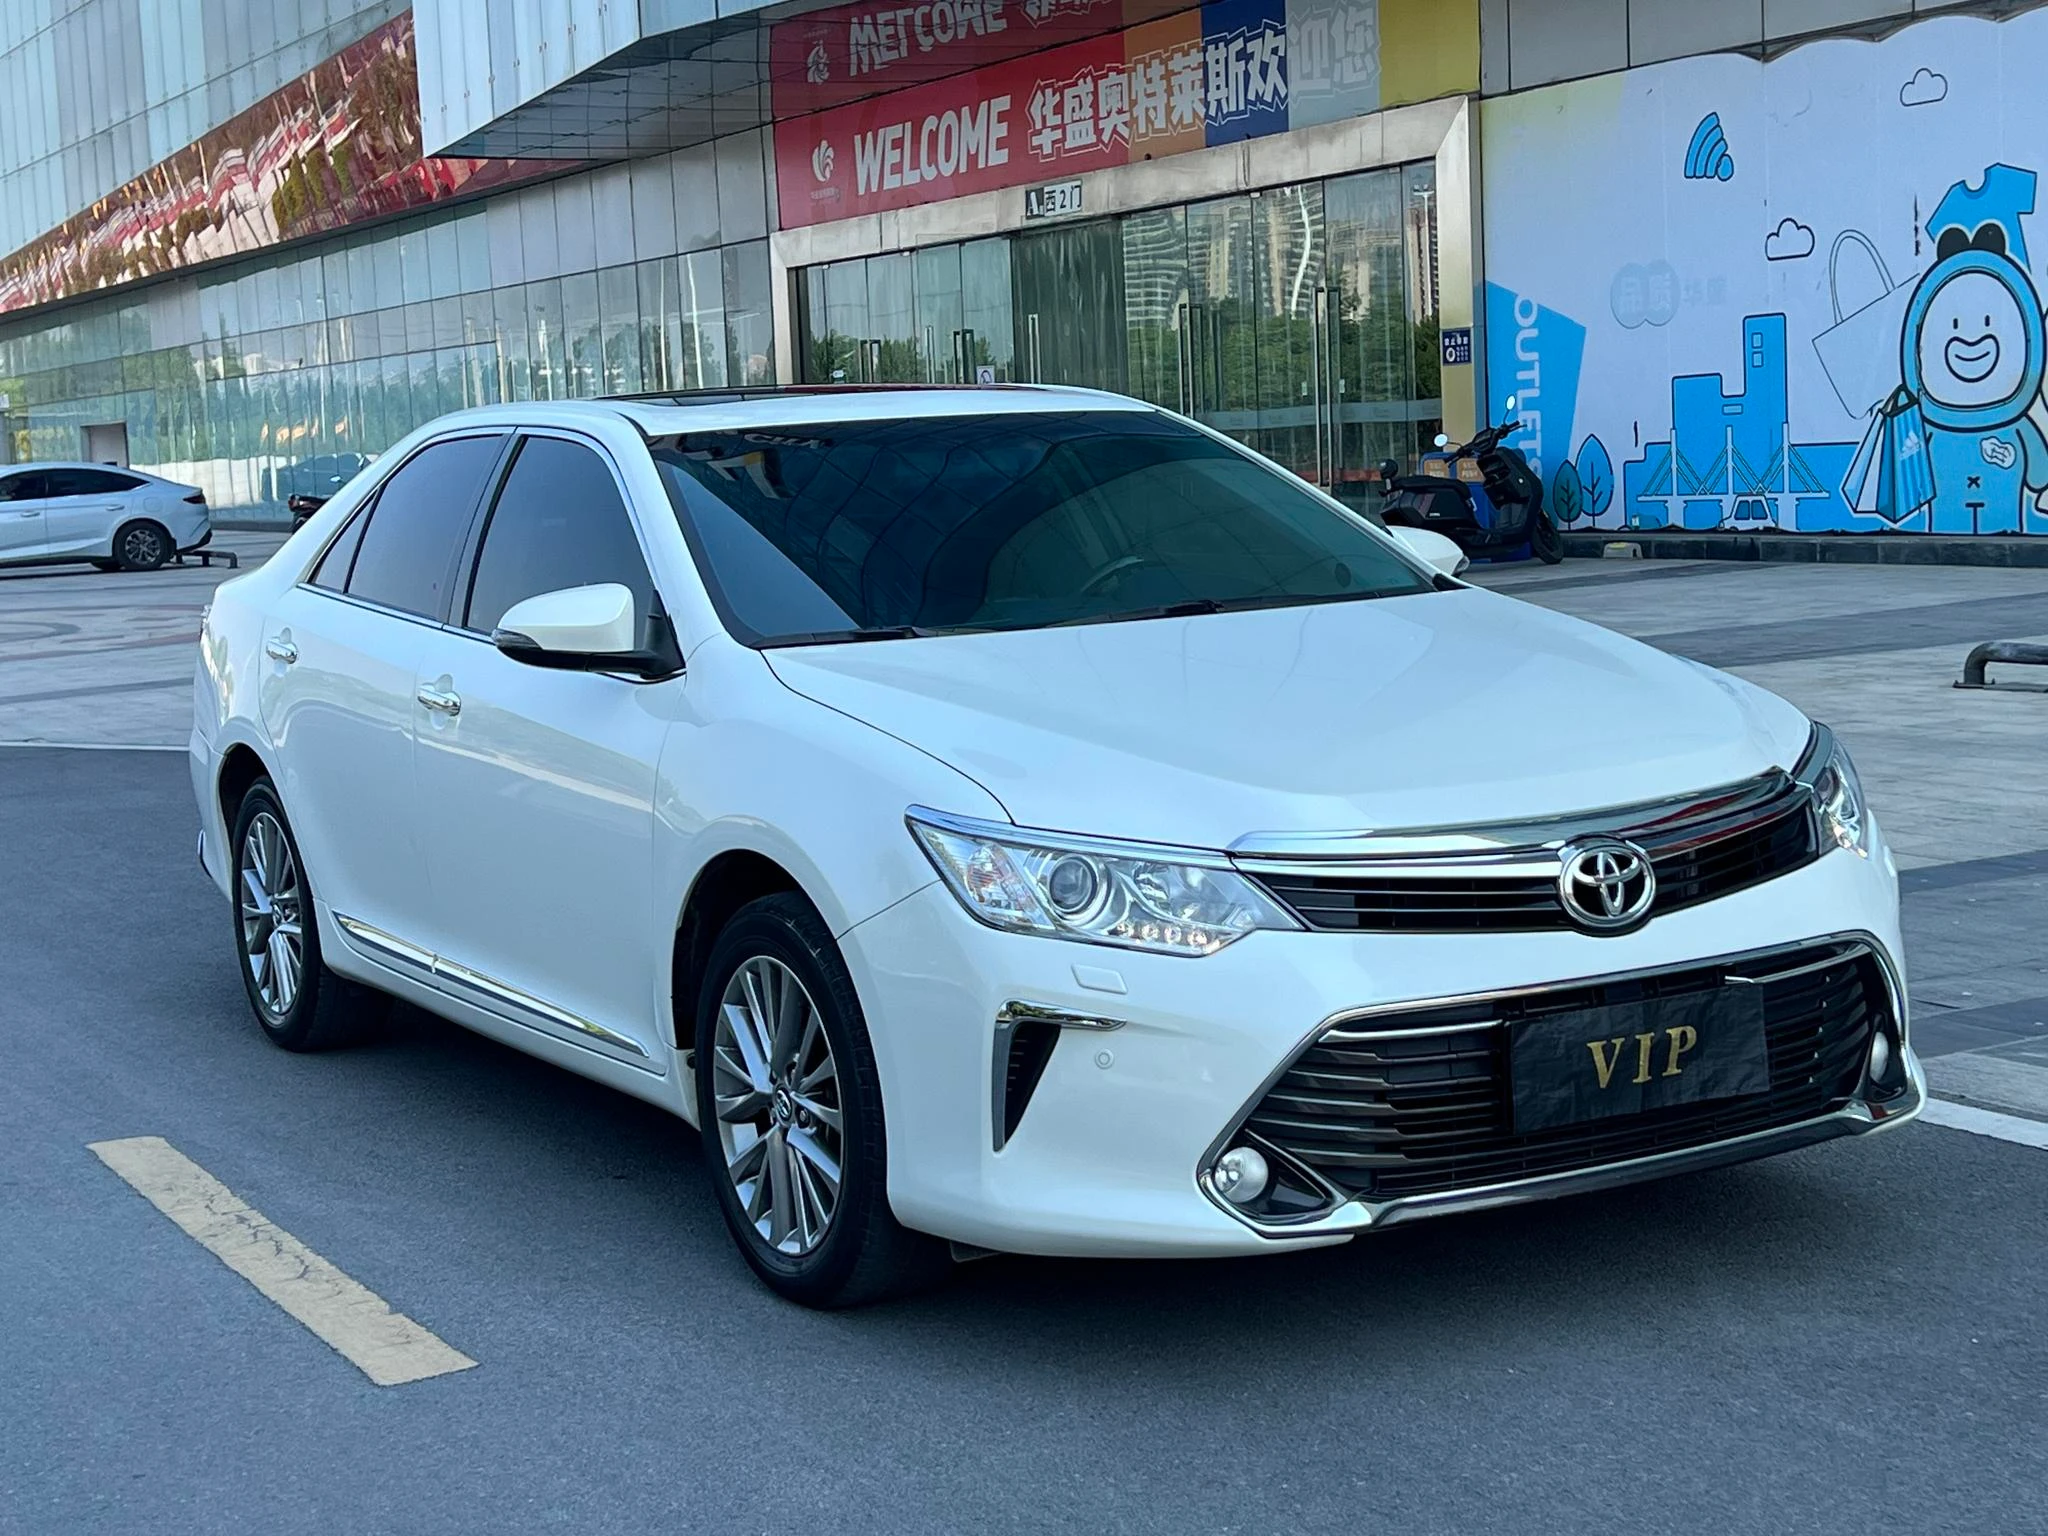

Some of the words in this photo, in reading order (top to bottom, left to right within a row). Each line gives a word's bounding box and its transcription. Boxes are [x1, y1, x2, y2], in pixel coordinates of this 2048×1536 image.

[1030, 6, 1376, 156] 华盛奥特莱斯欢迎您
[854, 94, 1011, 195] WELCOME
[1587, 1025, 1698, 1089] VIP
